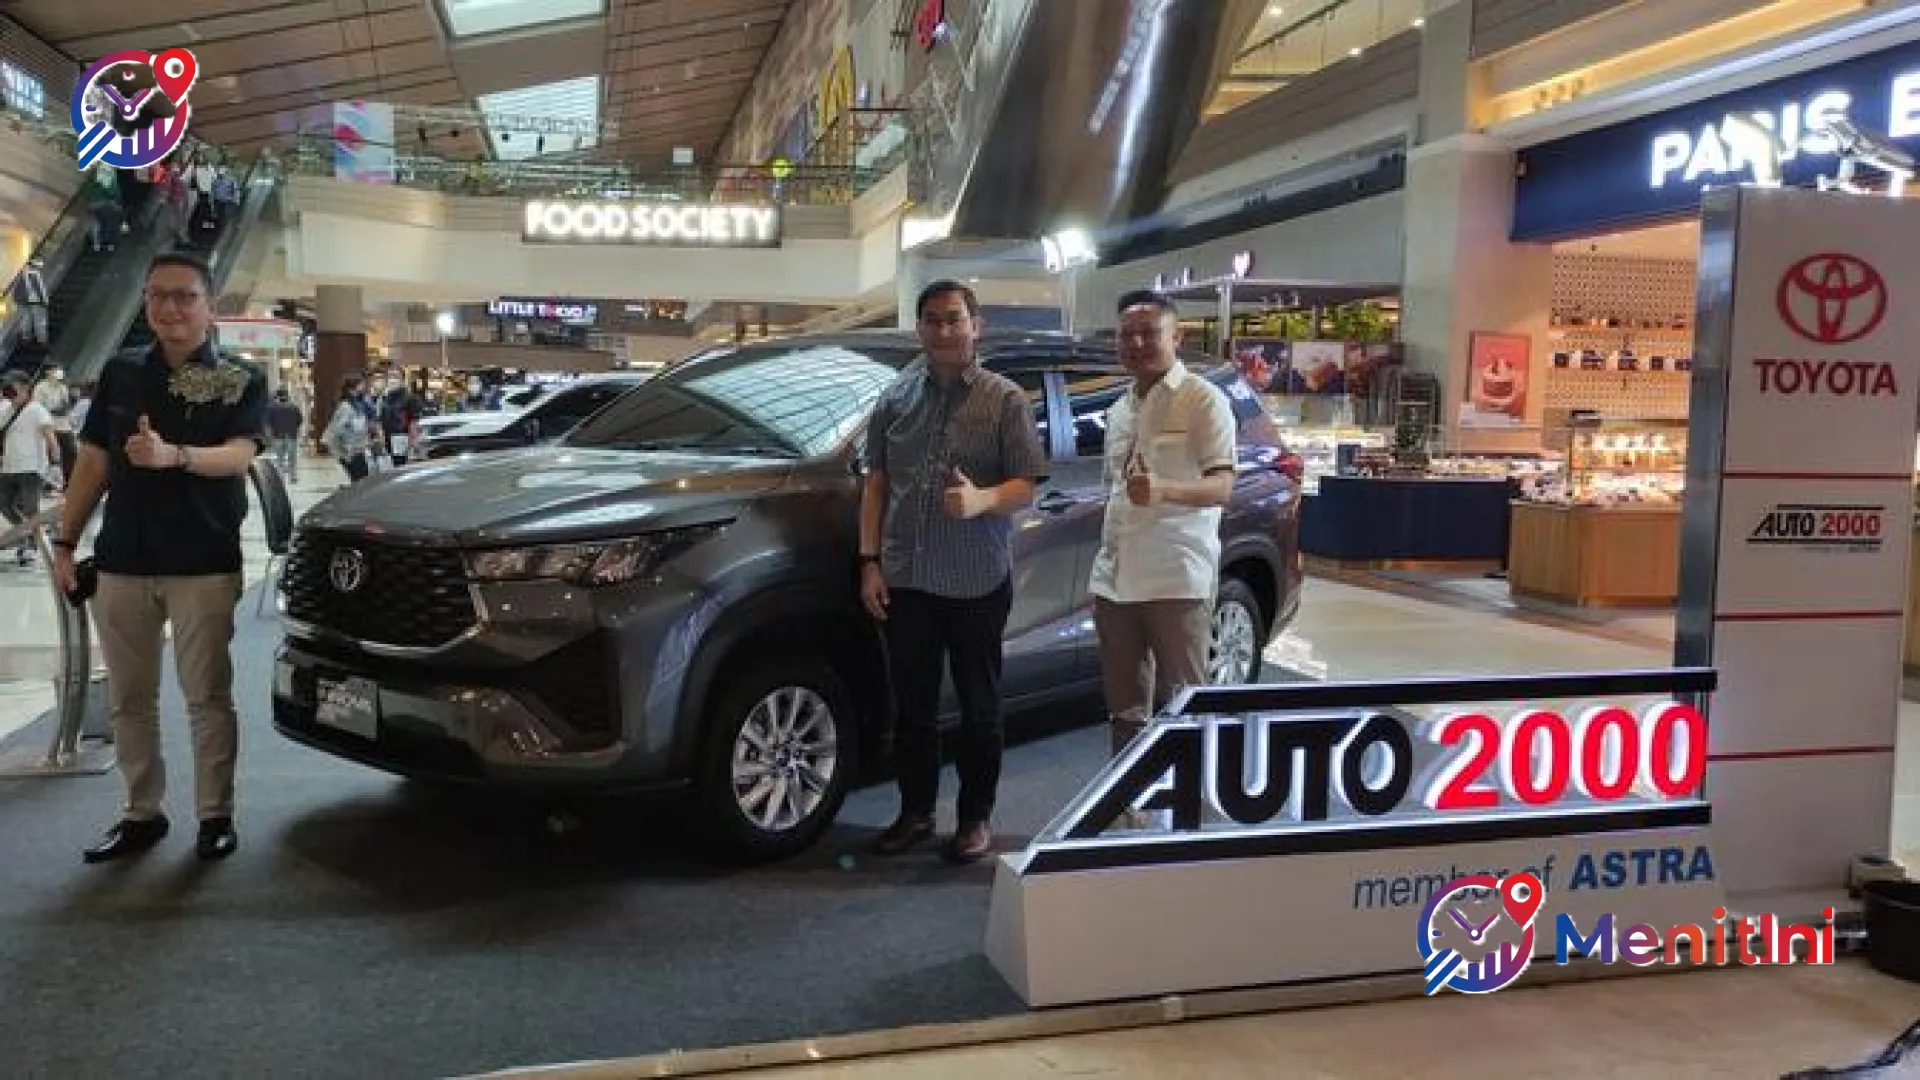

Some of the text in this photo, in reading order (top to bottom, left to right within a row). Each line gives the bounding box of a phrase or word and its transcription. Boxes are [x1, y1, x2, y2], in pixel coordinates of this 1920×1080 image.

[525, 200, 775, 240] FOOD SOCIETY
[1753, 358, 1898, 396] TOYOTA
[1753, 512, 1881, 537] AUTO 2000
[1061, 704, 1707, 839] AUTO 2000
[1569, 845, 1714, 890] ASTRA
